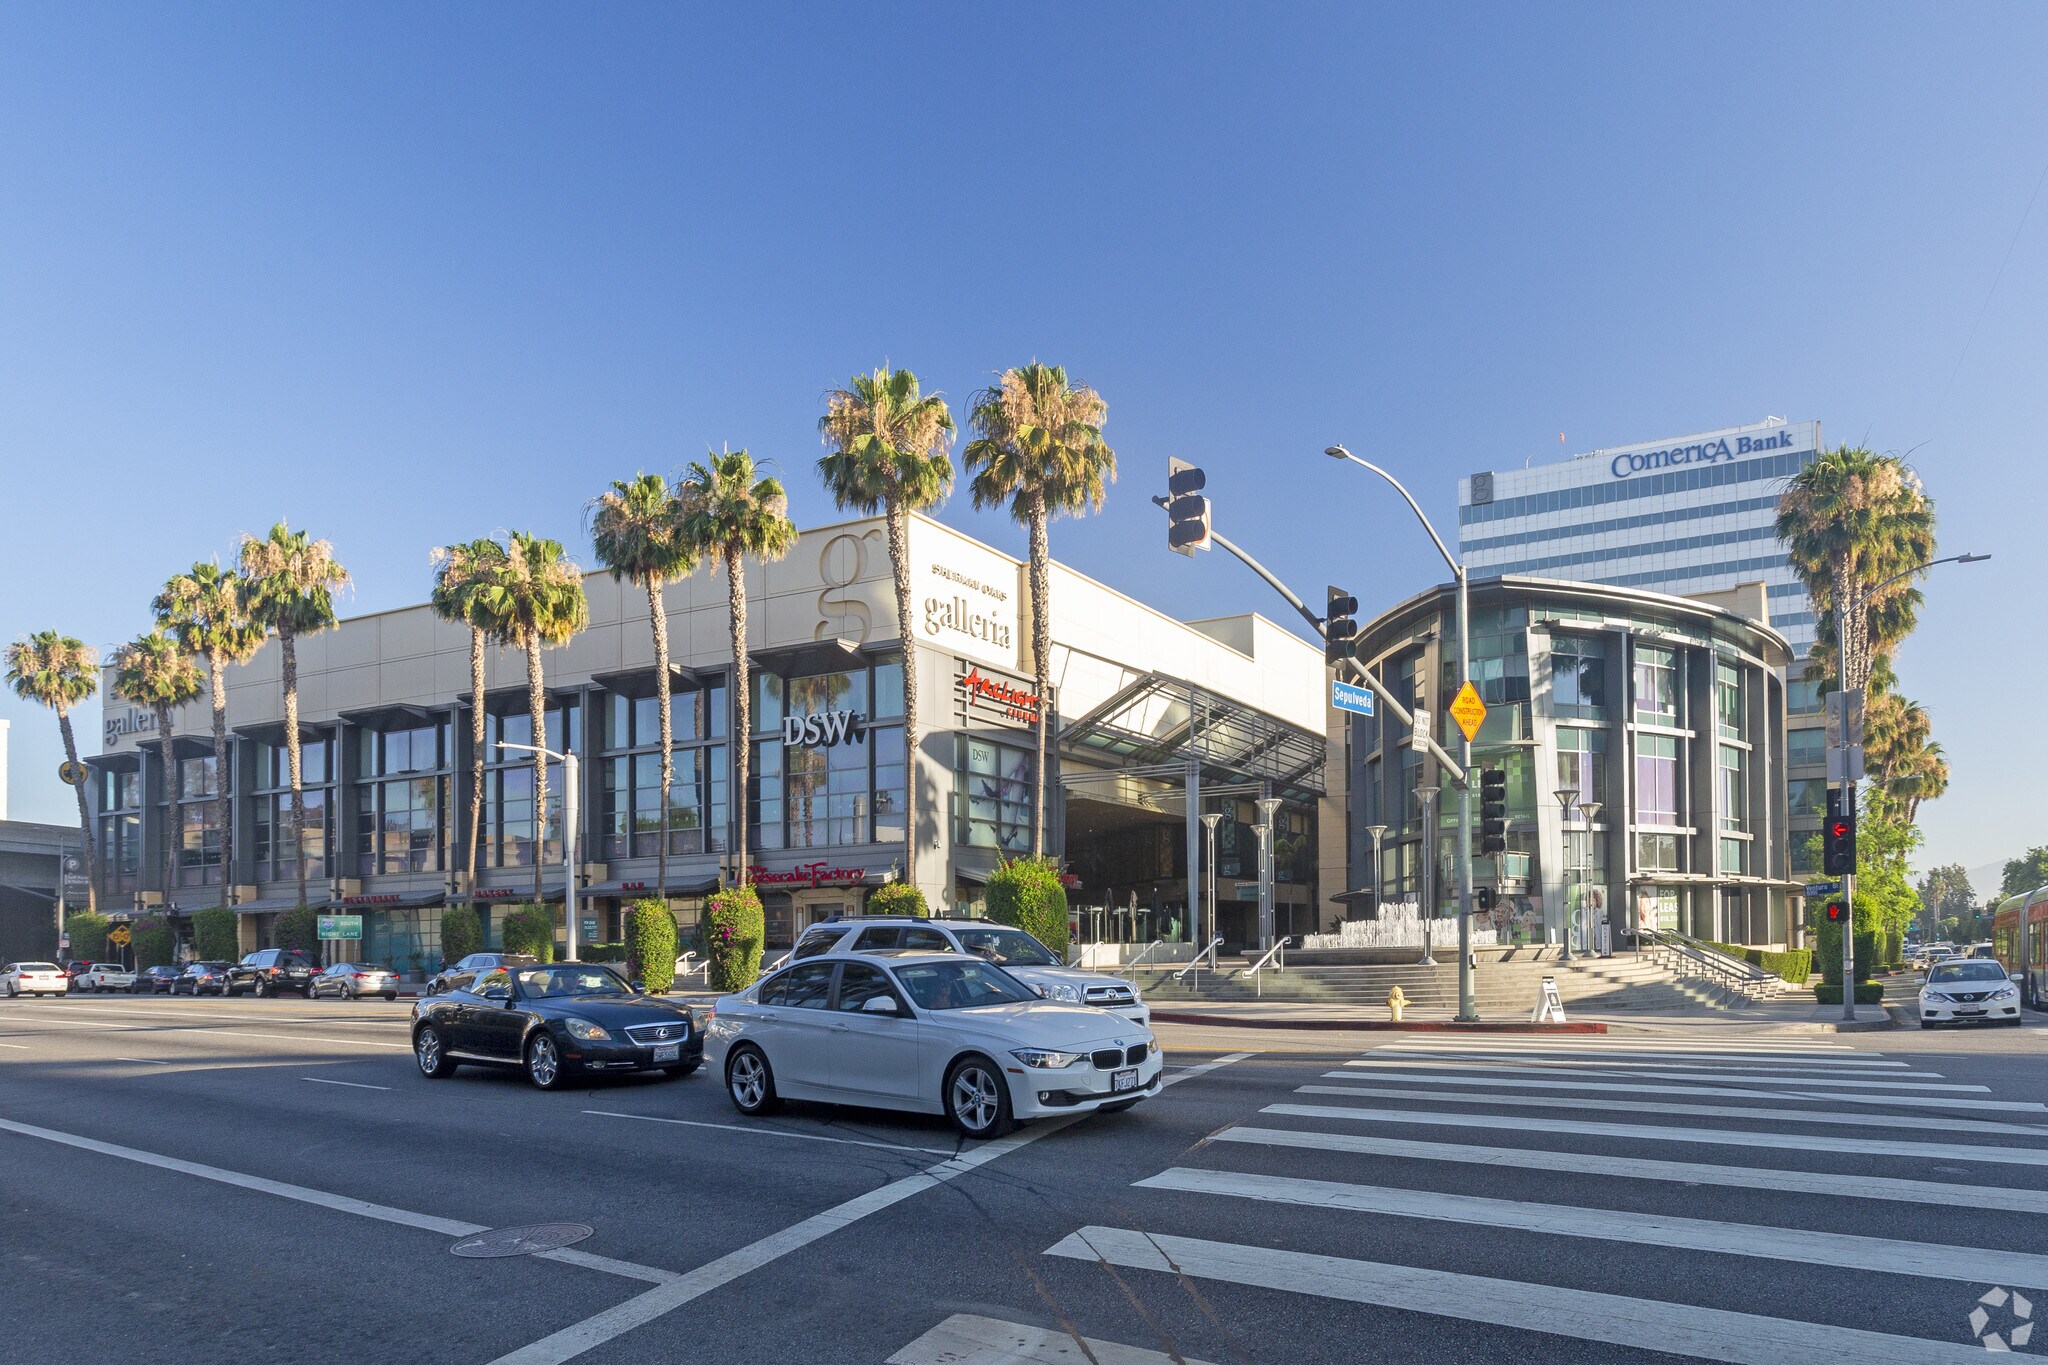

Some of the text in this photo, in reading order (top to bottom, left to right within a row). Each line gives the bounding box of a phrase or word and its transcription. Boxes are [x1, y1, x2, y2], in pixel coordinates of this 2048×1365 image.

[1736, 430, 1793, 455] Bank
[814, 529, 882, 644] g
[932, 563, 1007, 602] SHERMAN OAKS
[924, 596, 1011, 650] galleria
[1334, 687, 1371, 708] Sepulveda
[1461, 696, 1476, 705] ROAD
[1453, 706, 1484, 716] CONSTRUCTION
[106, 706, 174, 746] galler
[1415, 714, 1430, 726] DO NOT
[1462, 718, 1478, 727] AHEAD
[783, 709, 852, 746] DSW
[1414, 727, 1429, 738] BLOCK
[972, 748, 990, 763] DSW
[803, 861, 865, 889] Factory
[474, 888, 514, 897] BAKERY
[622, 882, 645, 890] BAR
[1659, 889, 1676, 899] FOR
[1659, 902, 1679, 912] LEAS
